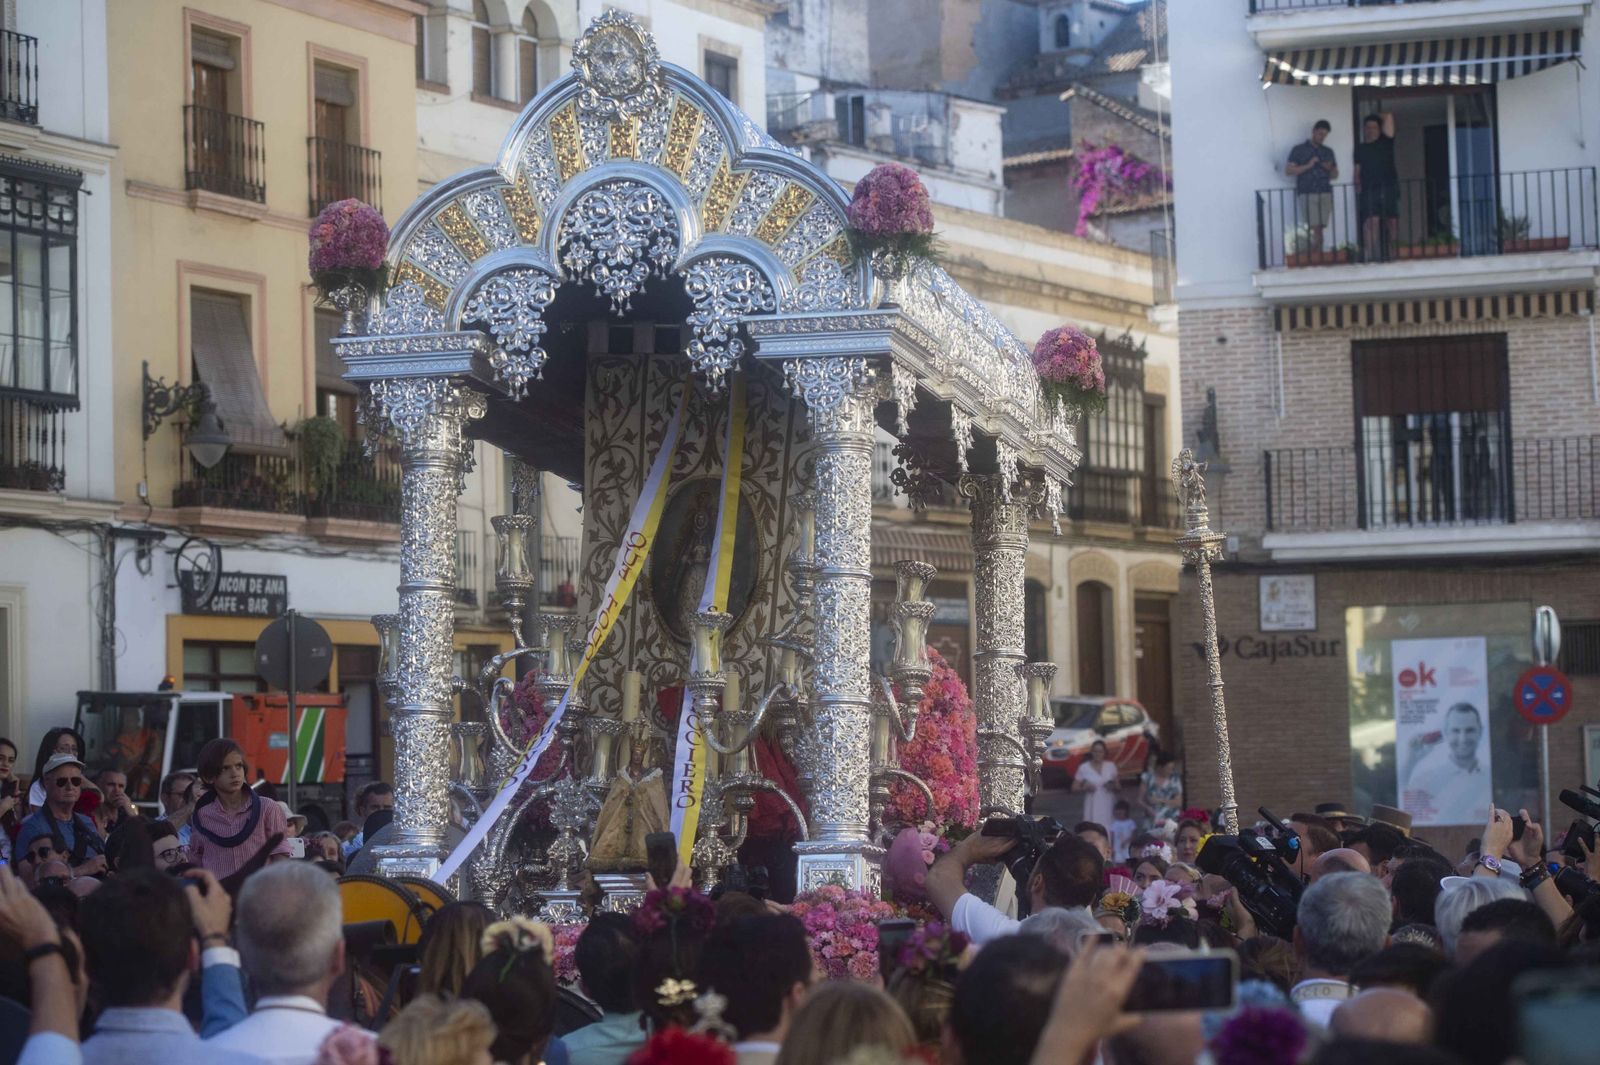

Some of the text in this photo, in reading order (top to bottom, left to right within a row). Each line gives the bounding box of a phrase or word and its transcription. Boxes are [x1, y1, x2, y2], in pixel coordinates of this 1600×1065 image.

[617, 531, 647, 581] QUE
[249, 578, 262, 594] DE
[264, 578, 285, 595] ANA
[211, 595, 237, 612] CAFE
[247, 597, 268, 614] BAR
[1235, 634, 1340, 665] CajaSur
[1398, 661, 1437, 688] ok
